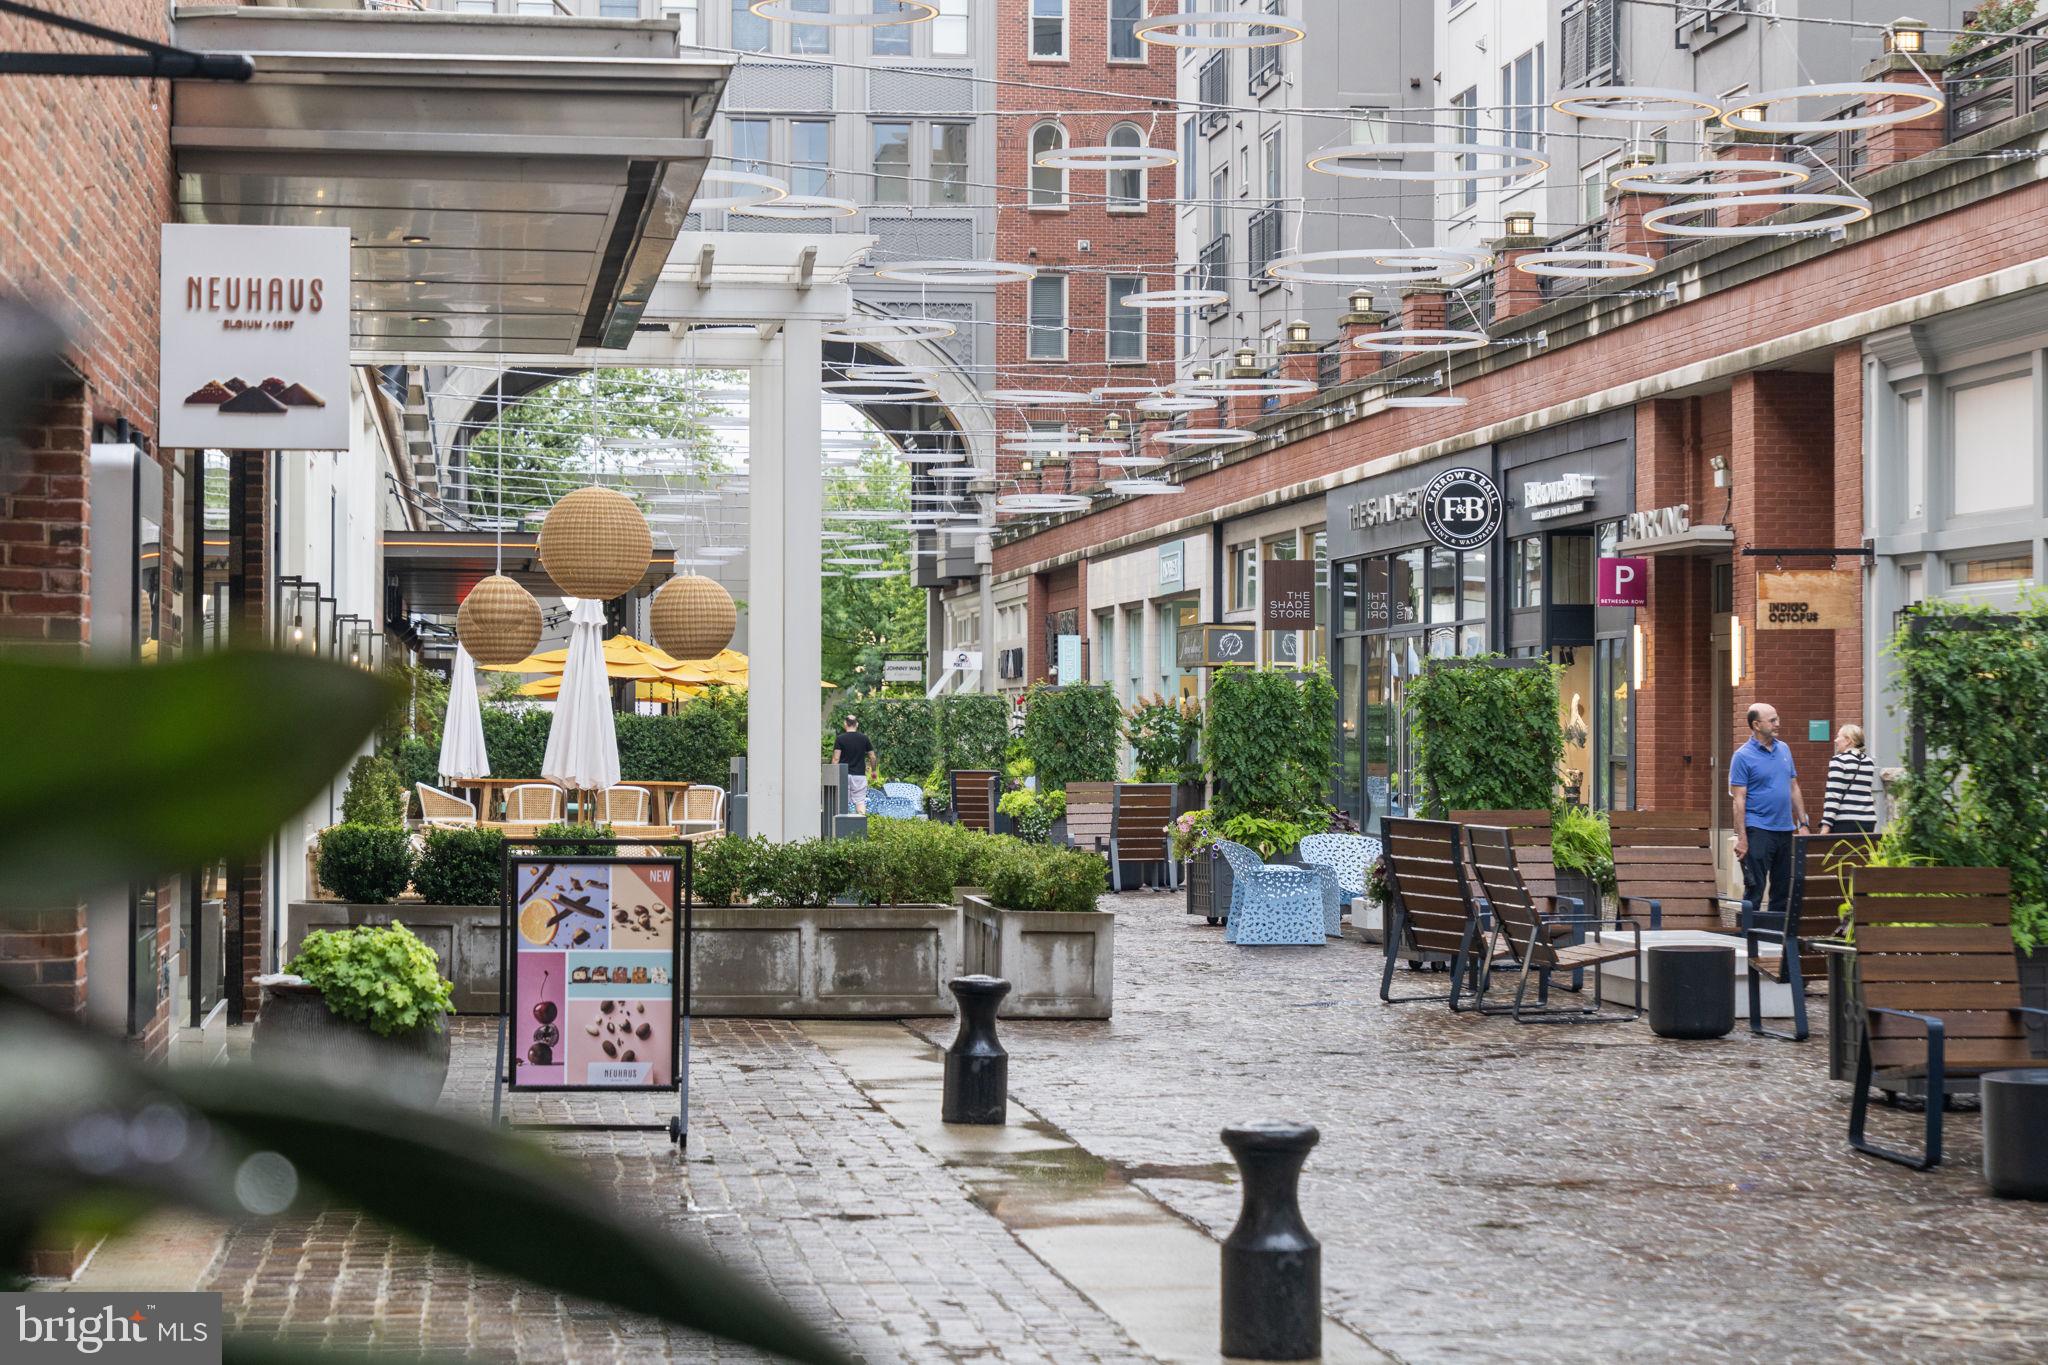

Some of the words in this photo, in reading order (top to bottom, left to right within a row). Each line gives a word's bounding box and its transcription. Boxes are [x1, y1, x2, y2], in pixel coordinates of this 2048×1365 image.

[187, 276, 323, 313] NEUHAUS
[1427, 472, 1465, 503] FARROW
[1469, 473, 1476, 481] &
[1479, 478, 1498, 504] BALL
[1629, 503, 1690, 539] PARKING
[1431, 521, 1449, 540] PAINT
[1459, 521, 1496, 545] WALLPAPER
[1615, 565, 1635, 595] P
[1286, 591, 1310, 600] THE
[1270, 600, 1310, 609] SHADE
[1768, 602, 1809, 613] INDIGO
[1270, 610, 1310, 619] STORE
[1768, 612, 1818, 622] OCTOPUS
[650, 869, 671, 883] NEW
[604, 1069, 637, 1079] NEUHAUS
